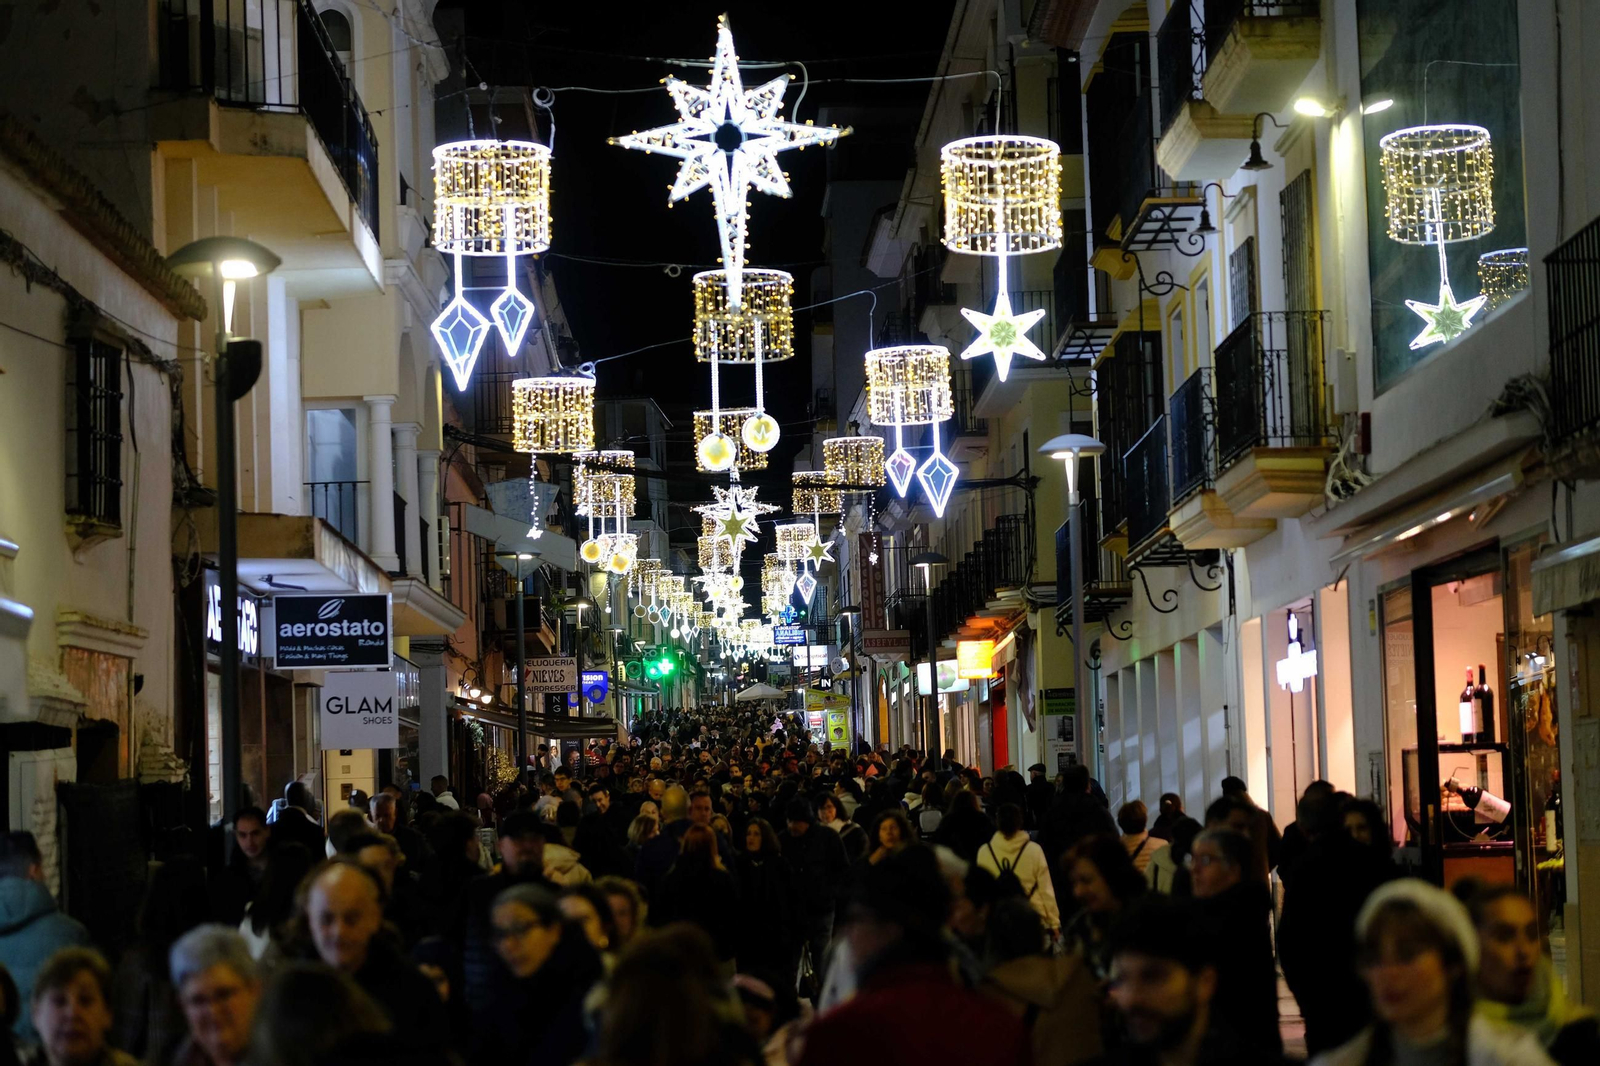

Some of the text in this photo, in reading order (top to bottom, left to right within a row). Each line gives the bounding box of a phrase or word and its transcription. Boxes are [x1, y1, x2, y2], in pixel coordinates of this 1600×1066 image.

[280, 619, 384, 637] aerostato
[328, 652, 349, 661] Things
[532, 669, 566, 683] NIEVES
[821, 679, 831, 688] IN
[325, 696, 393, 714] GLAM
[362, 716, 393, 725] SHOES
